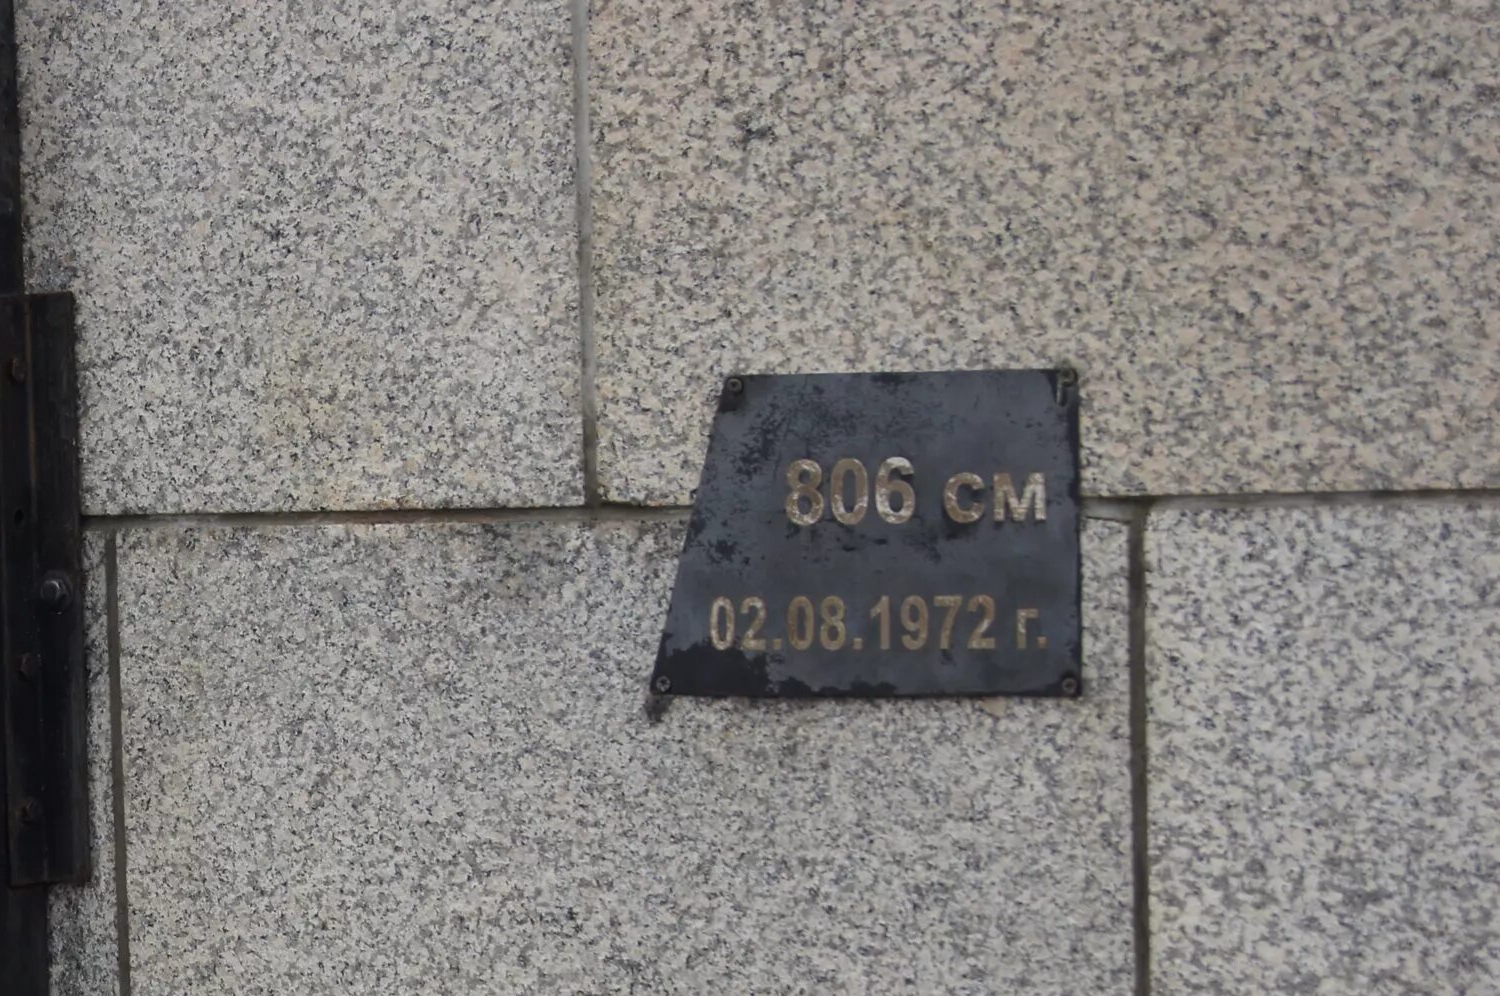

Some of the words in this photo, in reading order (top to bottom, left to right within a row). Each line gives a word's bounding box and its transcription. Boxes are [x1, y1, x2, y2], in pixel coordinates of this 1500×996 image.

[785, 456, 916, 526] 806
[709, 595, 996, 652] 02.08.1972
[1016, 608, 1049, 650] г.
